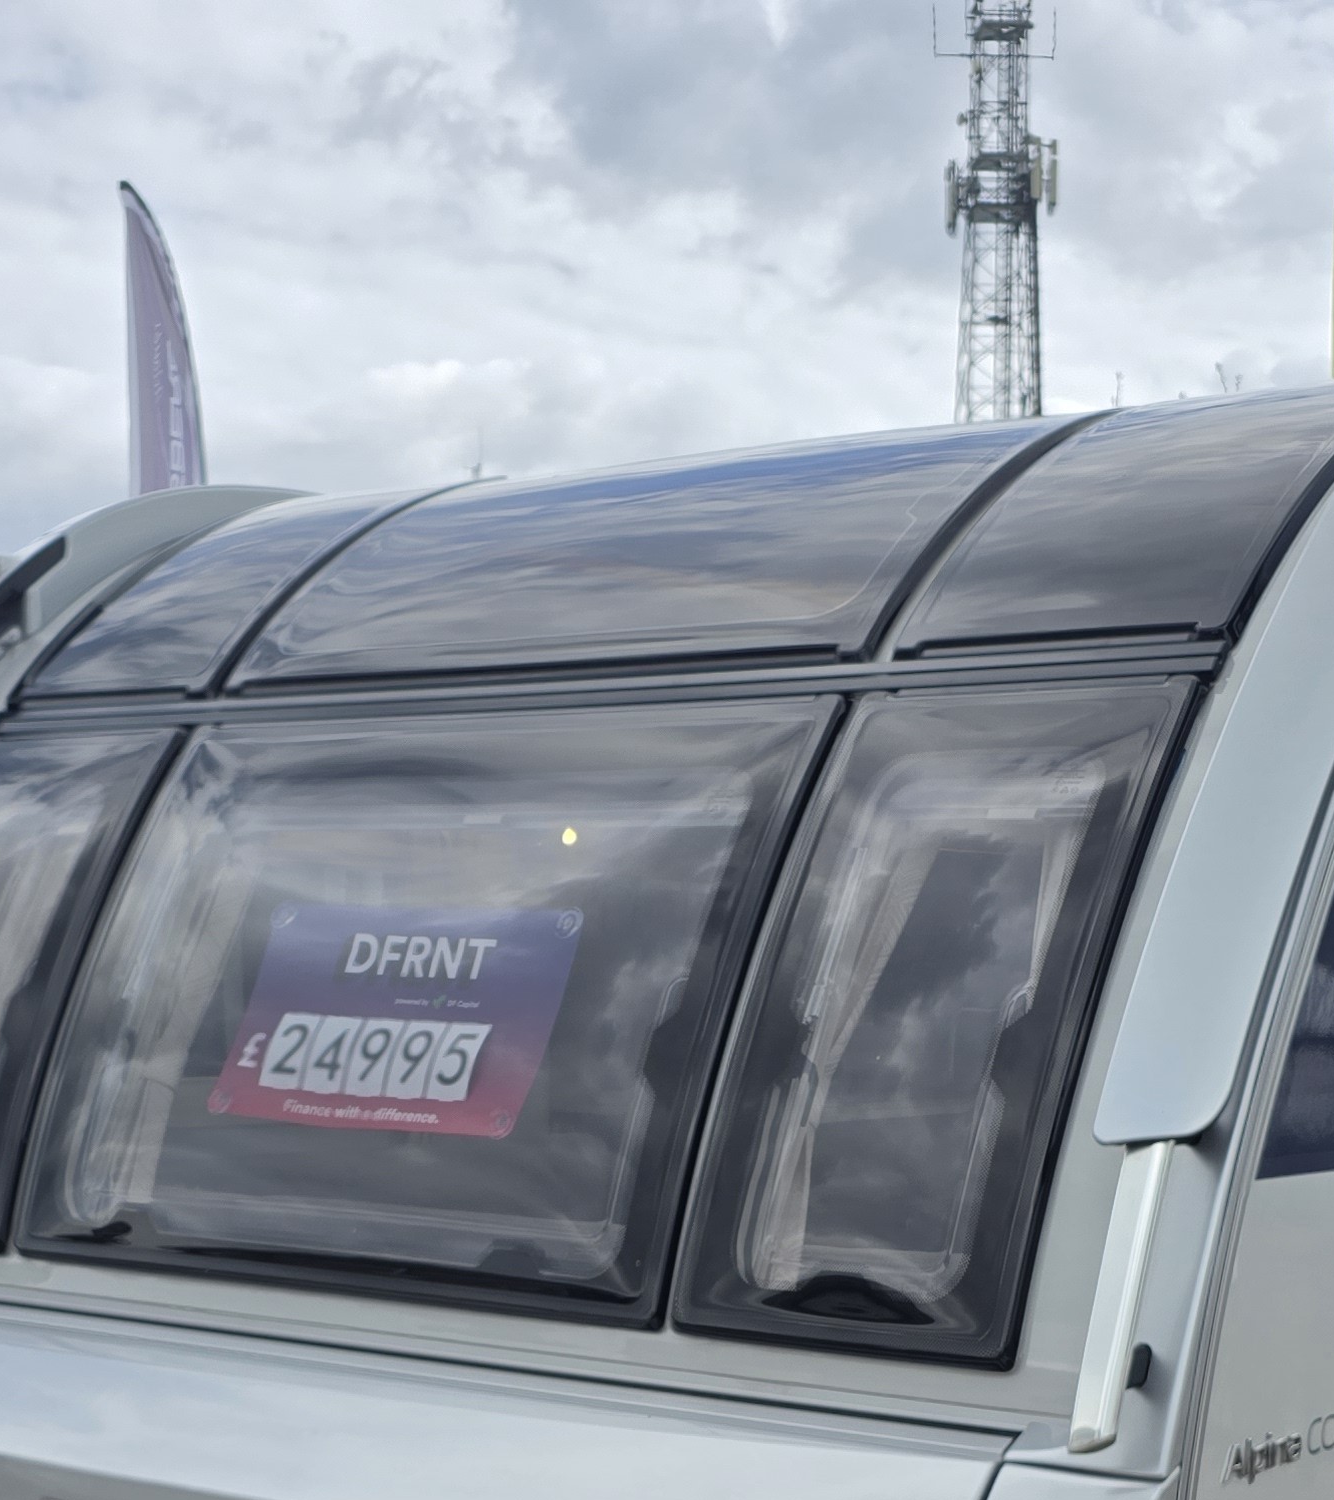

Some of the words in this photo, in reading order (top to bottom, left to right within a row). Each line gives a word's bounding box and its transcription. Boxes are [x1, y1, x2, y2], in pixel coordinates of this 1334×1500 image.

[345, 932, 497, 980] DFRNT
[282, 1098, 332, 1118] Finance
[1219, 1432, 1303, 1485] Alpina
